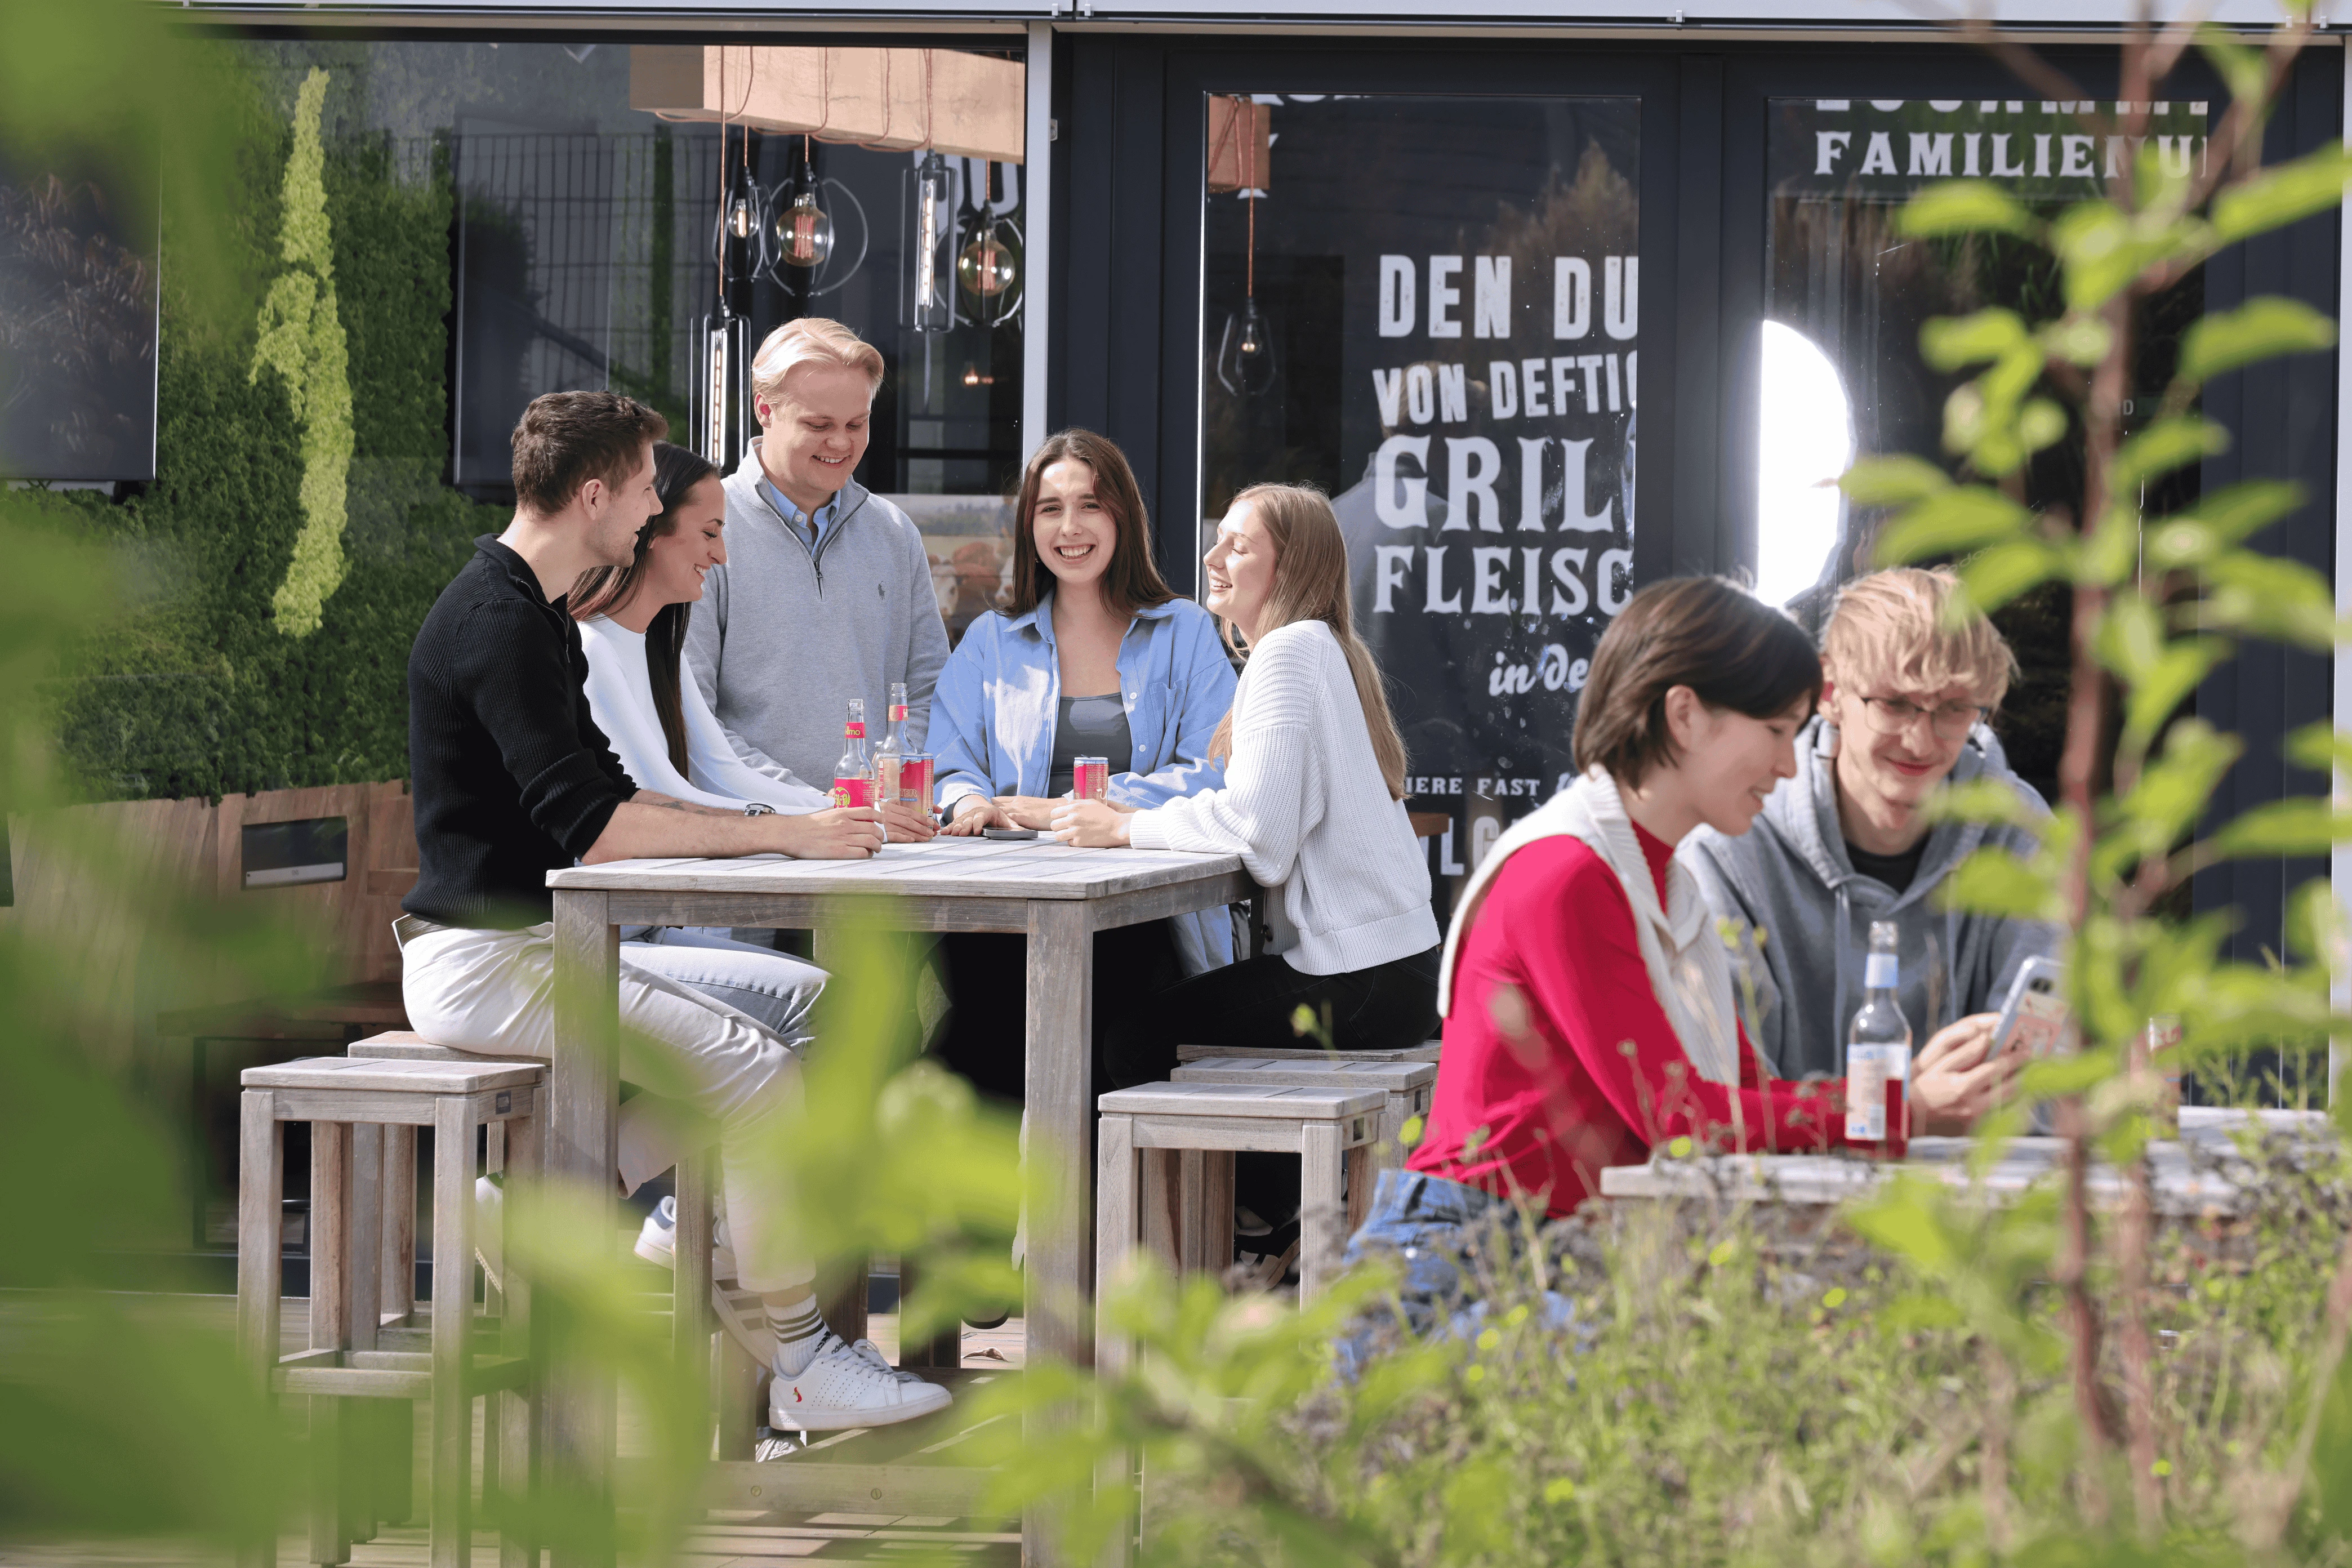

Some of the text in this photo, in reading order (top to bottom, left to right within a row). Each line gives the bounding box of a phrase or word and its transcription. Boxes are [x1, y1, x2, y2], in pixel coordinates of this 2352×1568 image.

[1814, 131, 2207, 179] FAMILIENU
[1379, 255, 1512, 338] DEN
[1372, 363, 1467, 427] VON
[1375, 435, 1636, 533] GRIL
[1373, 545, 1633, 616] FLEISC
[1489, 651, 1536, 696] in
[900, 789, 917, 797] TER
[1477, 778, 1540, 796] FAST
